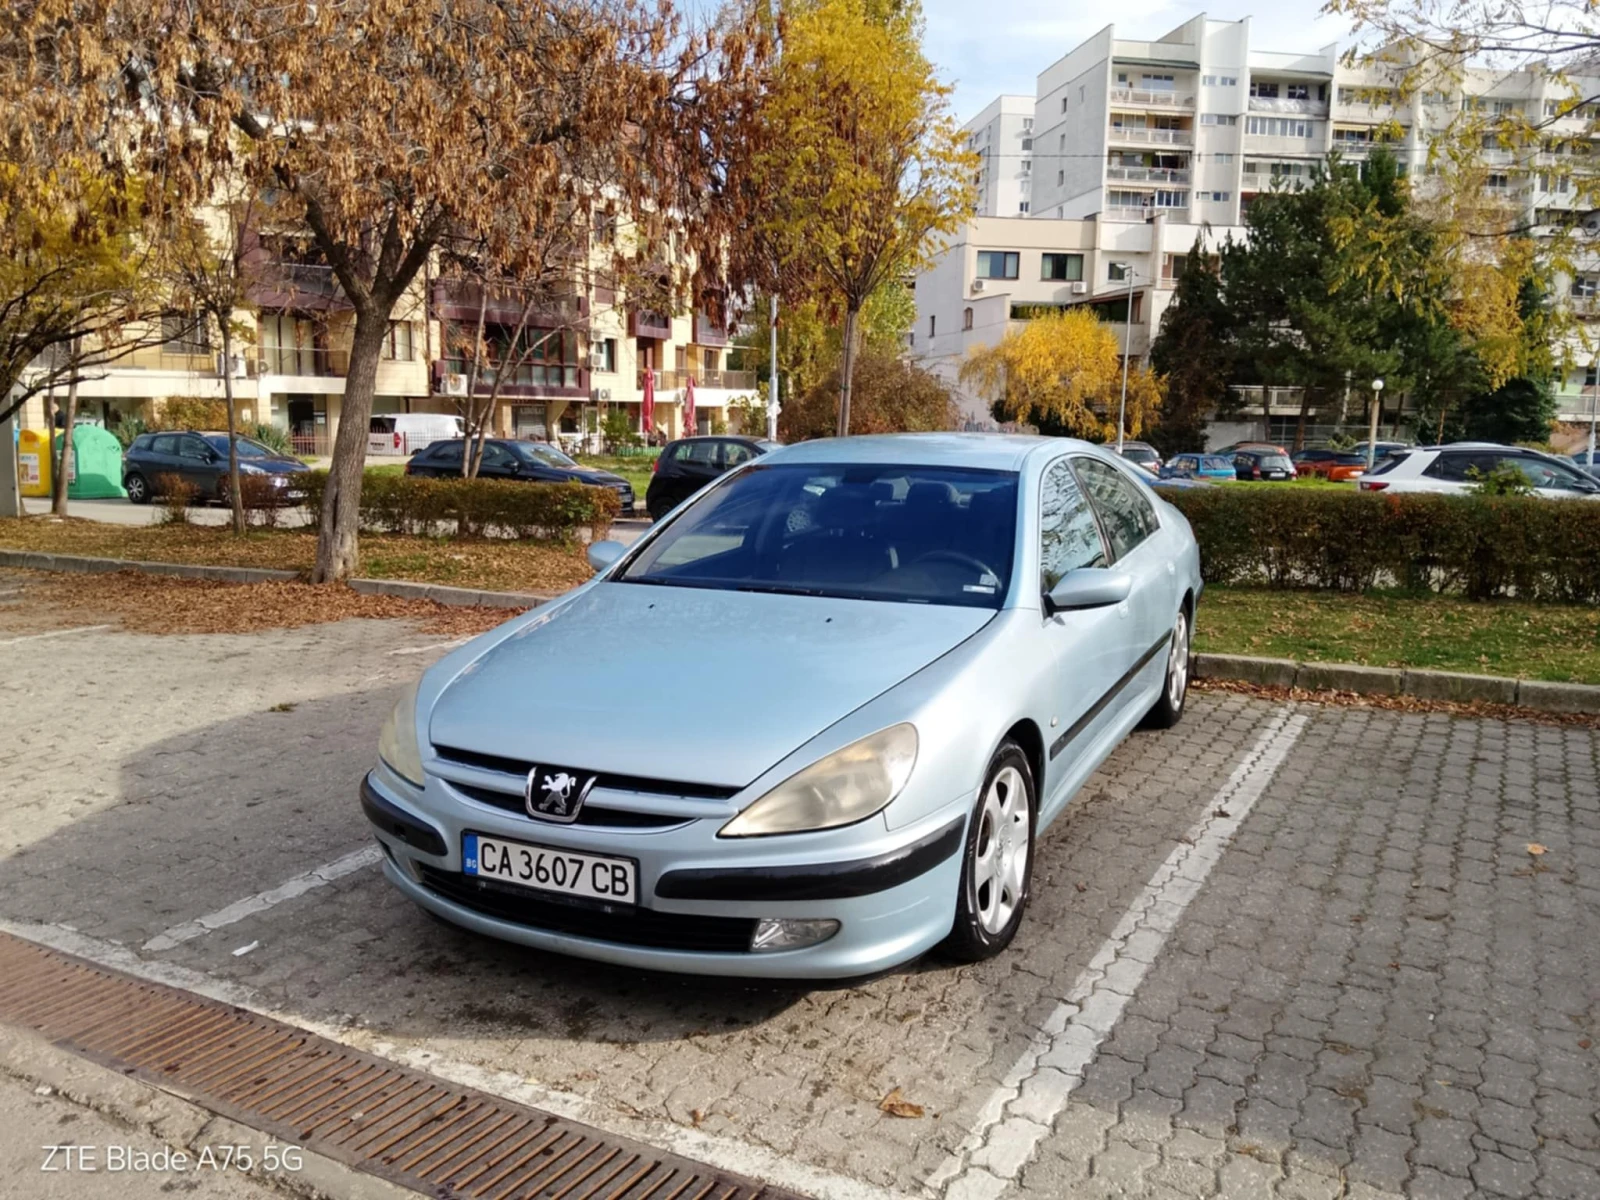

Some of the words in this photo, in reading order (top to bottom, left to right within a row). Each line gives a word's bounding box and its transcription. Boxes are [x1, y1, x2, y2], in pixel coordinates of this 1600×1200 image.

[465, 857, 477, 869] BG
[480, 842, 513, 877] CA
[519, 849, 584, 889] 3607
[591, 862, 629, 897] CB
